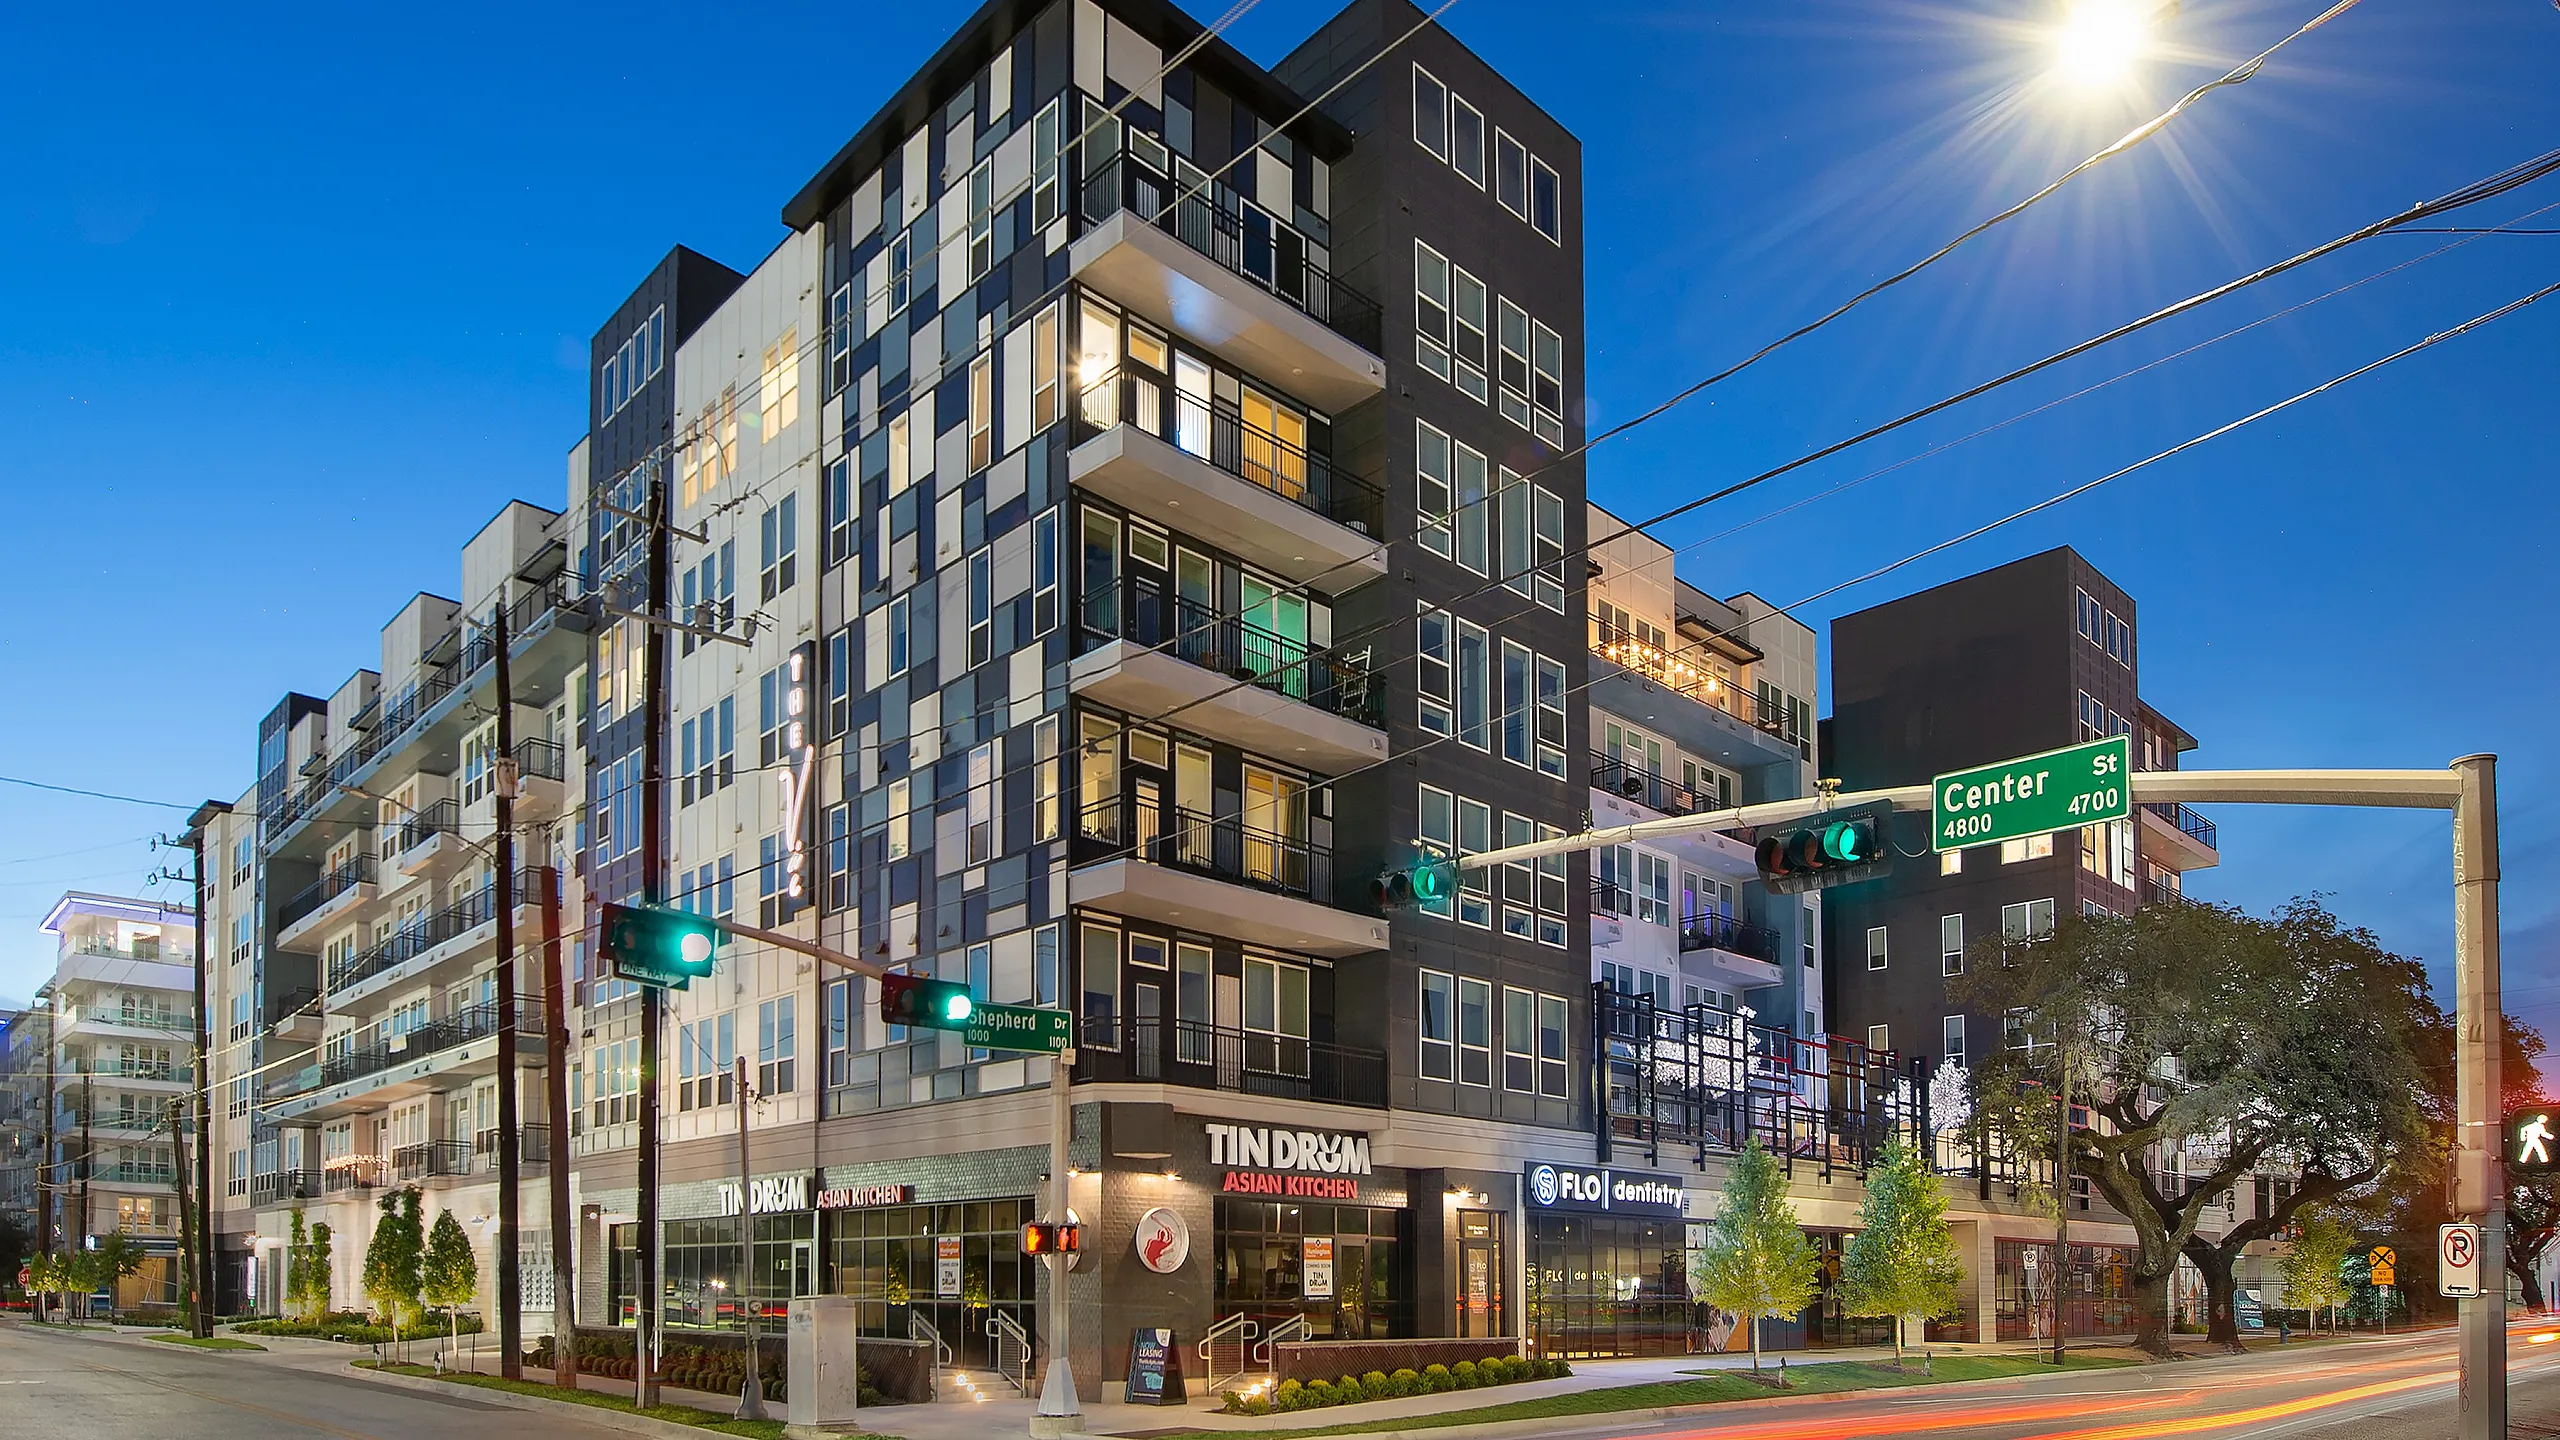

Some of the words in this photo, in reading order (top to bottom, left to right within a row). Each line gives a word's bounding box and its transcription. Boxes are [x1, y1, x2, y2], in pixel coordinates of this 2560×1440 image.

[789, 653, 803, 749] THE
[1944, 771, 2049, 812] Center
[2092, 753, 2118, 776] St
[1944, 813, 1992, 839] 4800
[2067, 788, 2118, 816] 4700
[622, 963, 643, 975] ONE
[647, 967, 667, 980] WAY
[968, 1008, 1036, 1031] Shepherd
[1054, 1017, 1067, 1030] Dr
[967, 1029, 990, 1042] 1000
[1049, 1036, 1067, 1049] 1100
[1206, 1123, 1269, 1168] TIN
[1272, 1130, 1372, 1175] DRUM
[718, 1183, 744, 1216] TIN
[750, 1176, 809, 1214] DRUM
[817, 1188, 850, 1208] ASIAN
[852, 1184, 904, 1206] KITCHEN
[1223, 1171, 1282, 1195] ASIAN
[1285, 1175, 1358, 1199] KITCHEN
[1560, 1171, 1601, 1202] FLO
[1612, 1179, 1684, 1210] dentistry
[1476, 1262, 1487, 1271] FLO
[1309, 1279, 1328, 1287] DRUM
[1139, 1348, 1163, 1358] LEASING
[1141, 1341, 1156, 1349] NOW
